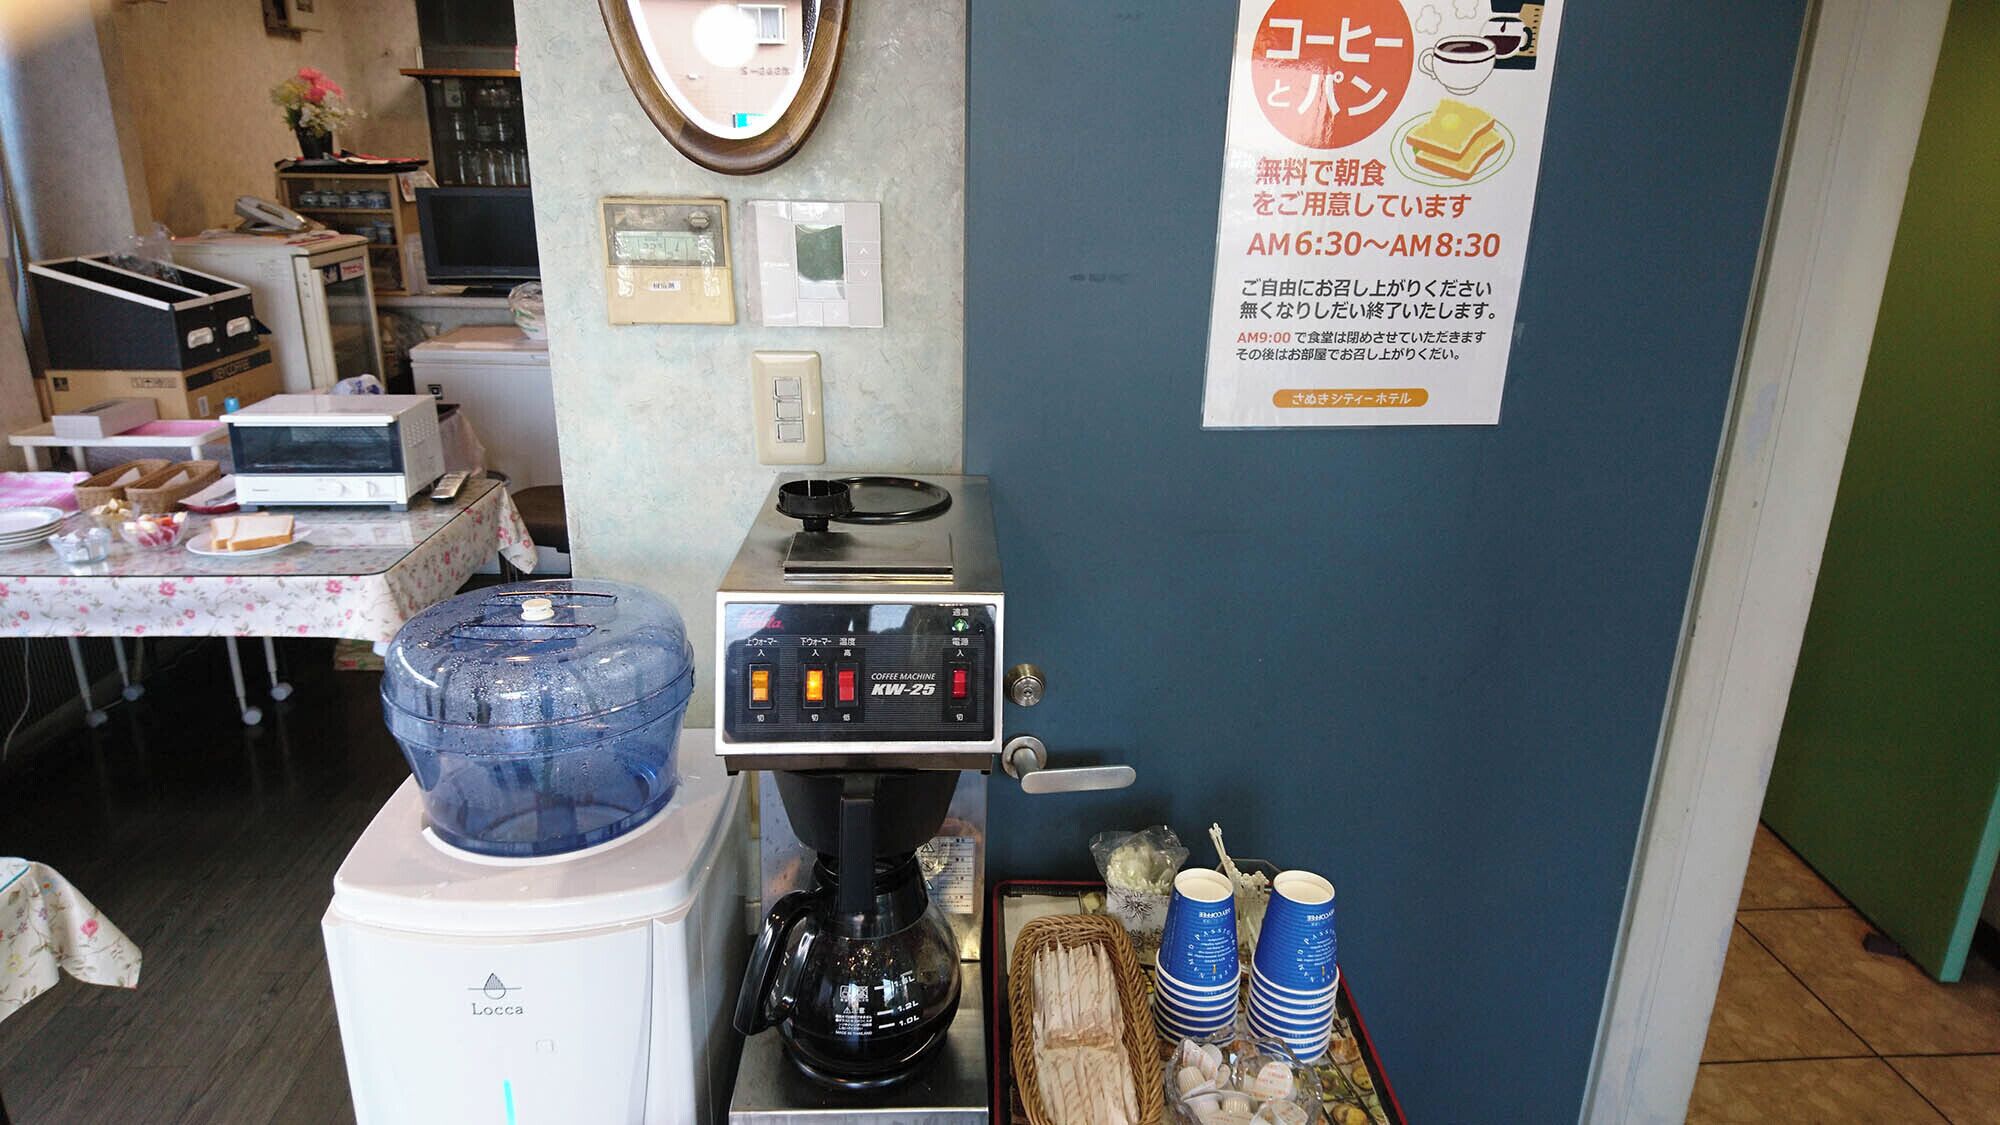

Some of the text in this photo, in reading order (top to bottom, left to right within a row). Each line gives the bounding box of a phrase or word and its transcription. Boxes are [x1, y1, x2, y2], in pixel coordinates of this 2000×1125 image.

[1266, 17, 1403, 63] コーヒー
[1267, 71, 1388, 116] とパン
[1255, 156, 1386, 187] 無料で朝食
[1252, 191, 1472, 218] をご用意しています
[1241, 278, 1492, 297] ご自由にお召し上がりください
[1239, 301, 1495, 320] 無くなりしだい終了いたします。
[1236, 330, 1486, 344] AM9:00 で食堂は閉めさせていただきます
[1235, 347, 1460, 361] その後はお部屋でお召し上がりくだい。
[1291, 392, 1412, 405] さぬきシティーホテル
[800, 637, 832, 646] 下ウォーマー
[844, 649, 852, 657] 高
[956, 649, 964, 657] 入
[871, 683, 936, 696] KW-25
[472, 1002, 523, 1015] Locca
[897, 1001, 919, 1012] 1.2L
[899, 1015, 920, 1027] 1.0L
